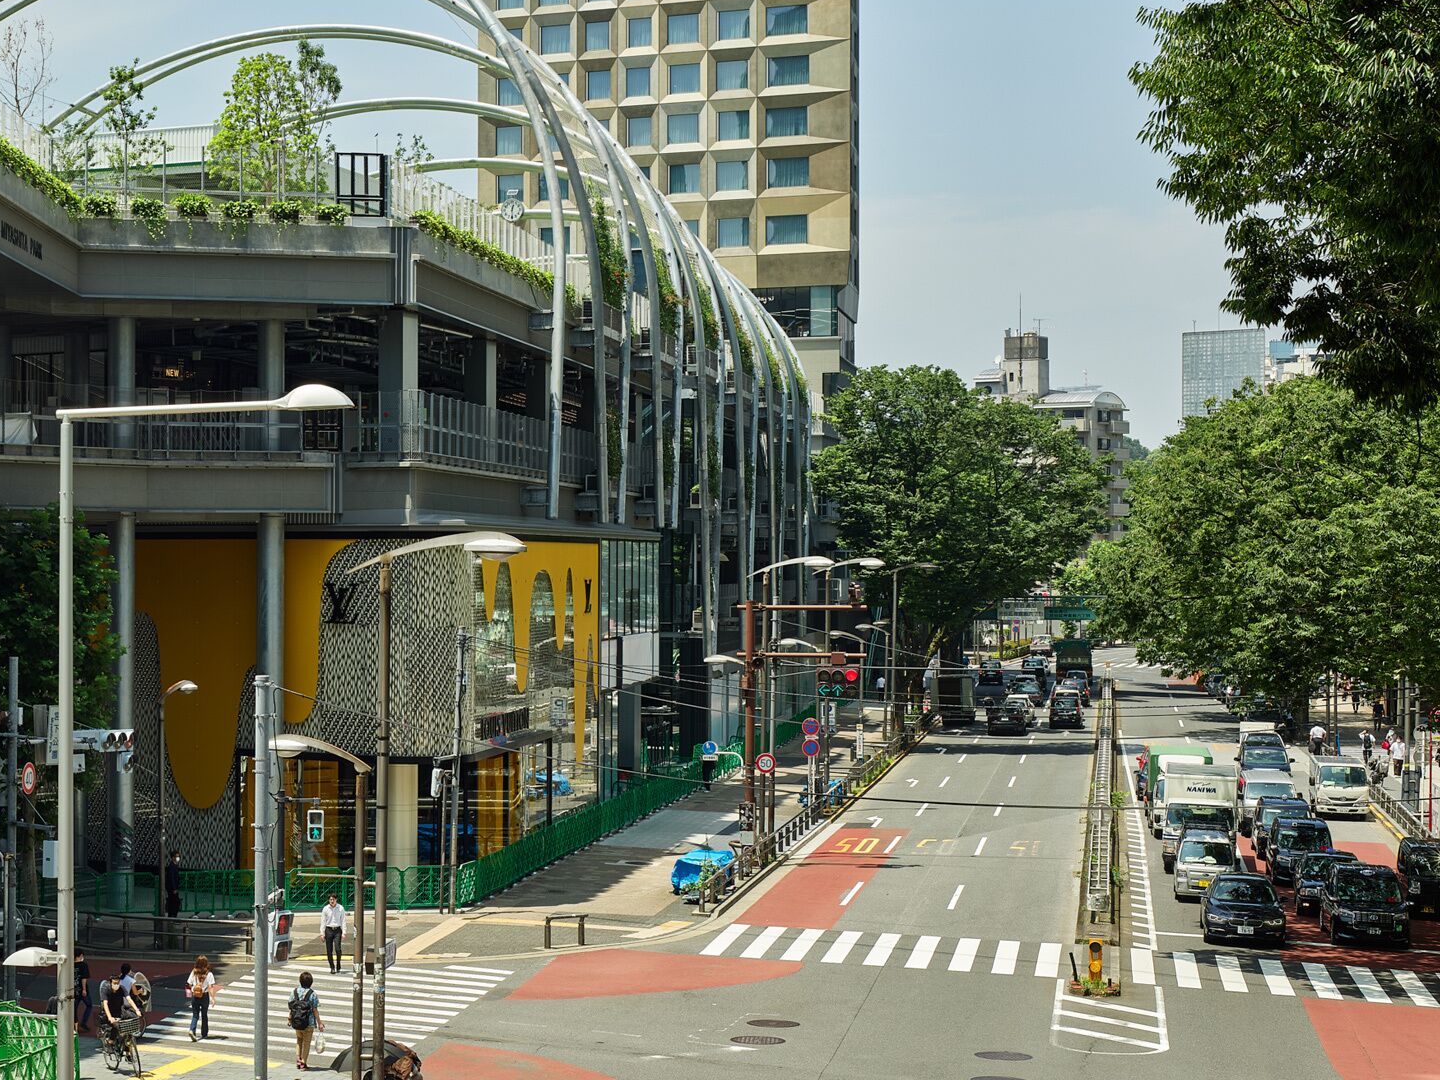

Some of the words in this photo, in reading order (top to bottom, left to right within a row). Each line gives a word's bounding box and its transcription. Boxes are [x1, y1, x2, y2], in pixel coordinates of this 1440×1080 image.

[1, 220, 28, 253] MIYASHITA
[29, 237, 43, 261] PARK
[760, 759, 772, 768] 50
[24, 772, 33, 786] 40
[1186, 786, 1216, 794] NANIWA
[828, 837, 881, 854] 50
